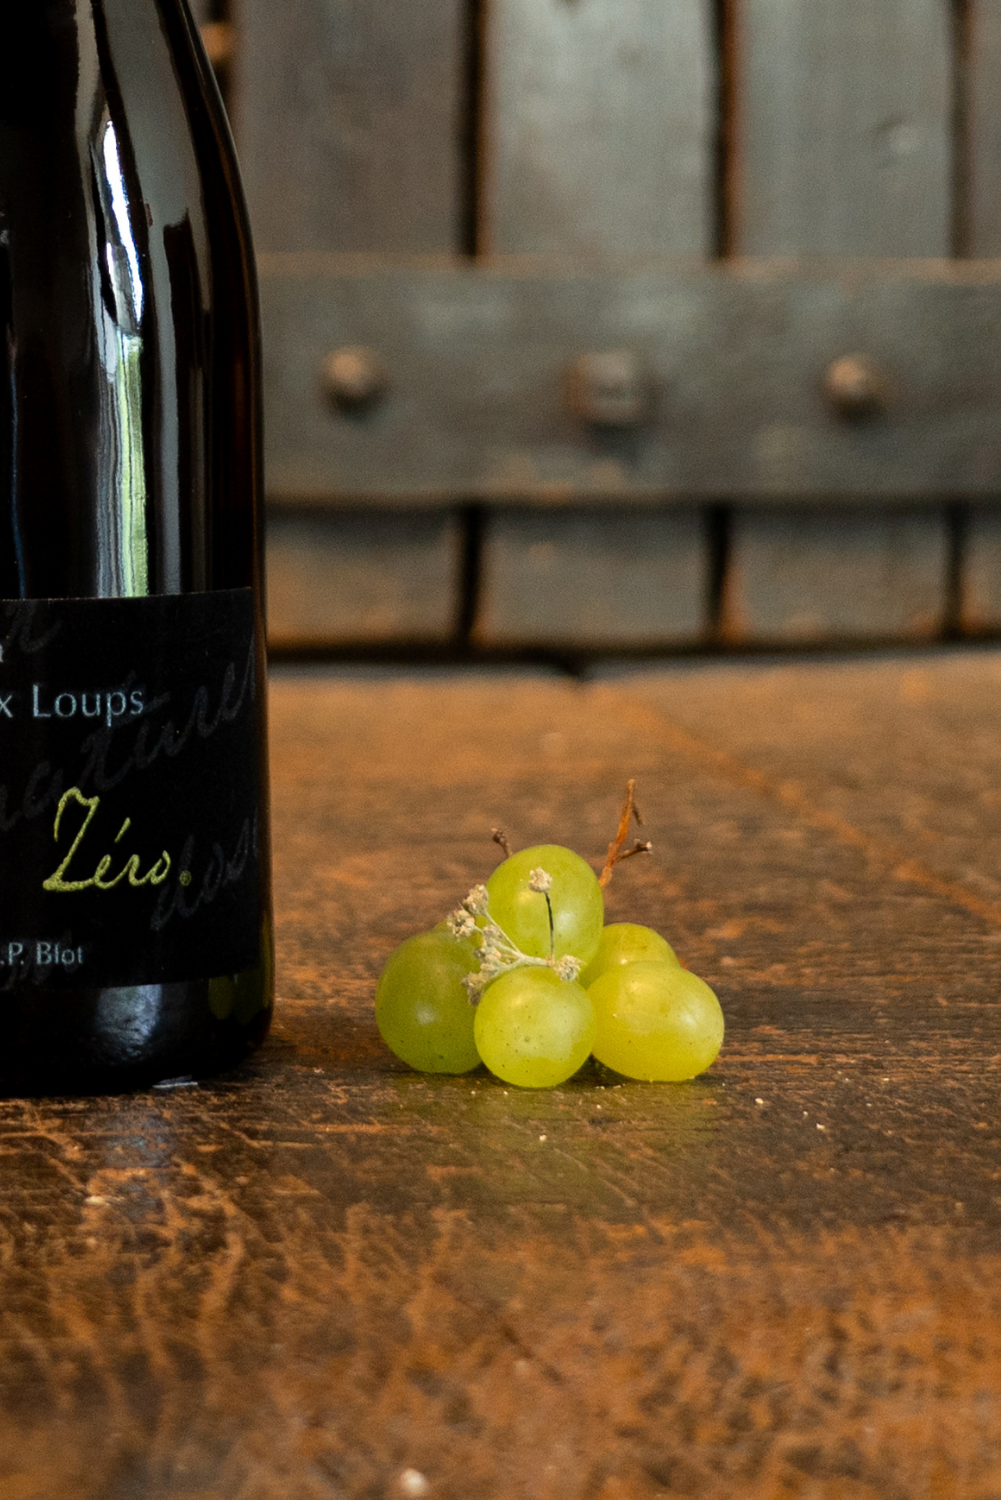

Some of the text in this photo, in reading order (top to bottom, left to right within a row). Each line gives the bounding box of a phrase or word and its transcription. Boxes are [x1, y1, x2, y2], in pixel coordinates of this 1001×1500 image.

[32, 685, 145, 727] Loups
[42, 787, 171, 892] Zéro
[36, 941, 85, 966] Blot
